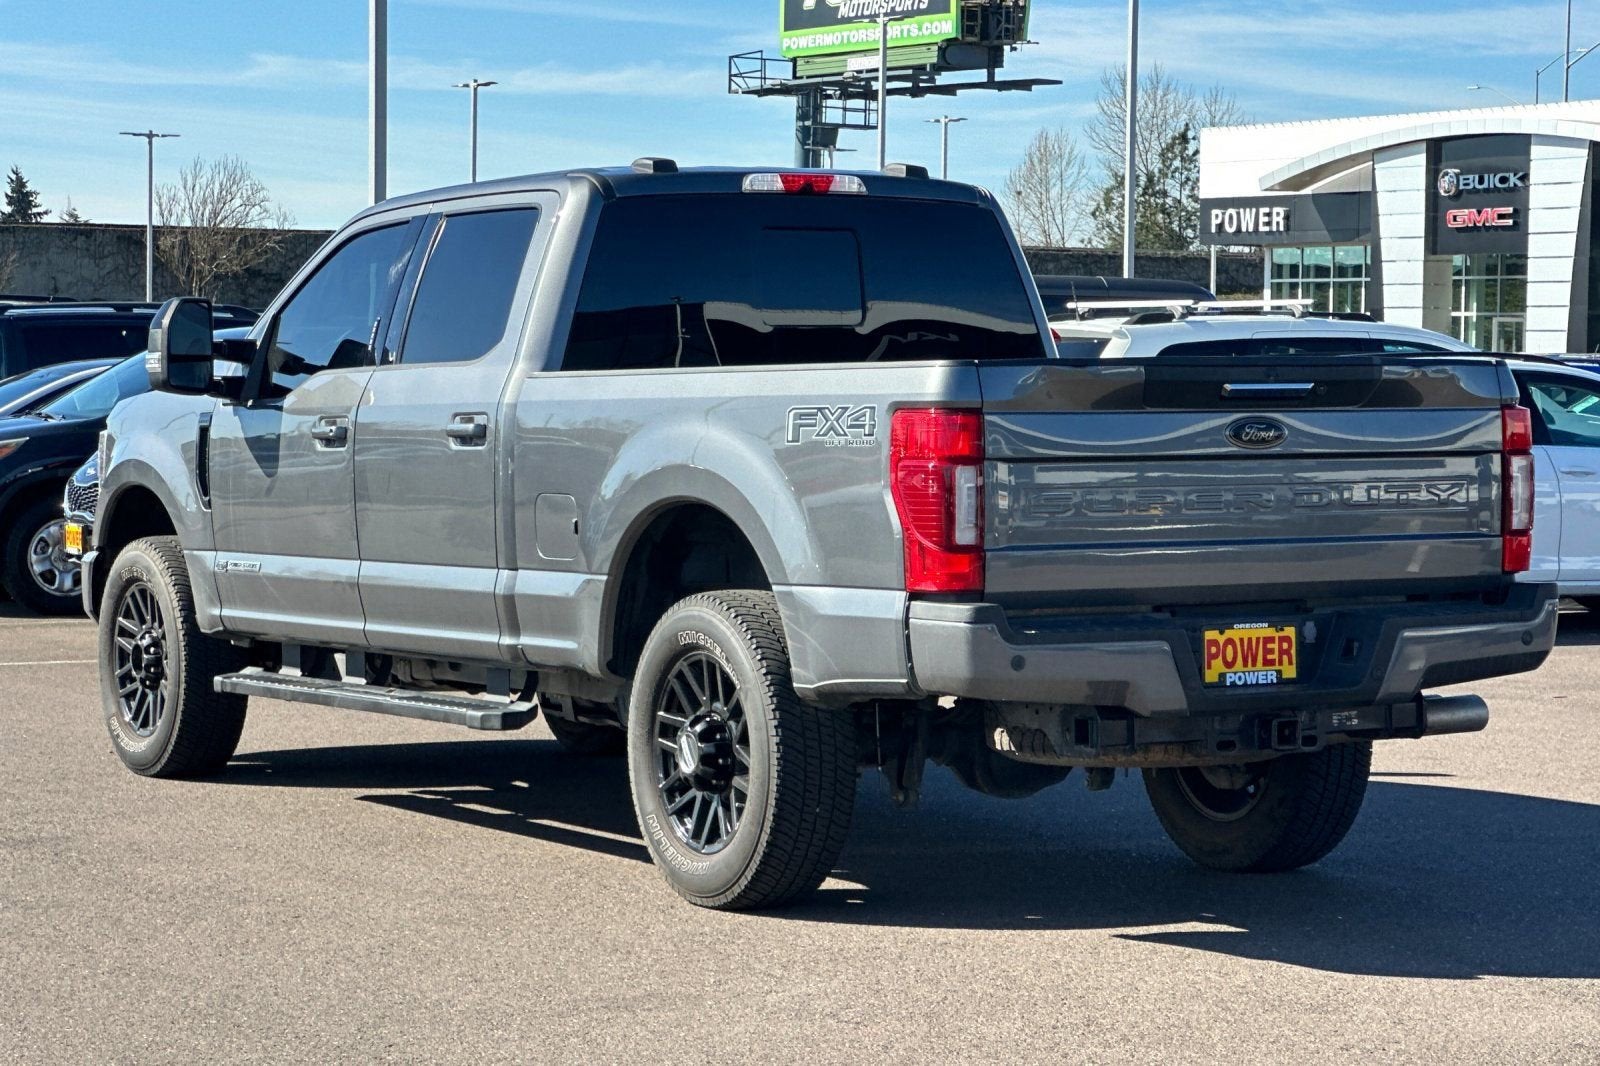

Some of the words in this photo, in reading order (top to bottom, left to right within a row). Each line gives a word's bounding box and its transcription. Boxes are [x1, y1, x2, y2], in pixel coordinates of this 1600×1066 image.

[1459, 172, 1525, 190] BUICK
[1211, 206, 1285, 233] POWER
[1446, 207, 1514, 228] GMC
[785, 404, 877, 445] FX4
[1242, 423, 1275, 441] Ford
[825, 439, 844, 447] OFF
[848, 439, 875, 447] ROAD
[1030, 488, 1276, 517] SUPER
[1293, 483, 1465, 508] DUTY
[1206, 635, 1294, 670] POWER
[1226, 670, 1277, 686] POWER
[645, 814, 710, 875] MICHELIN
